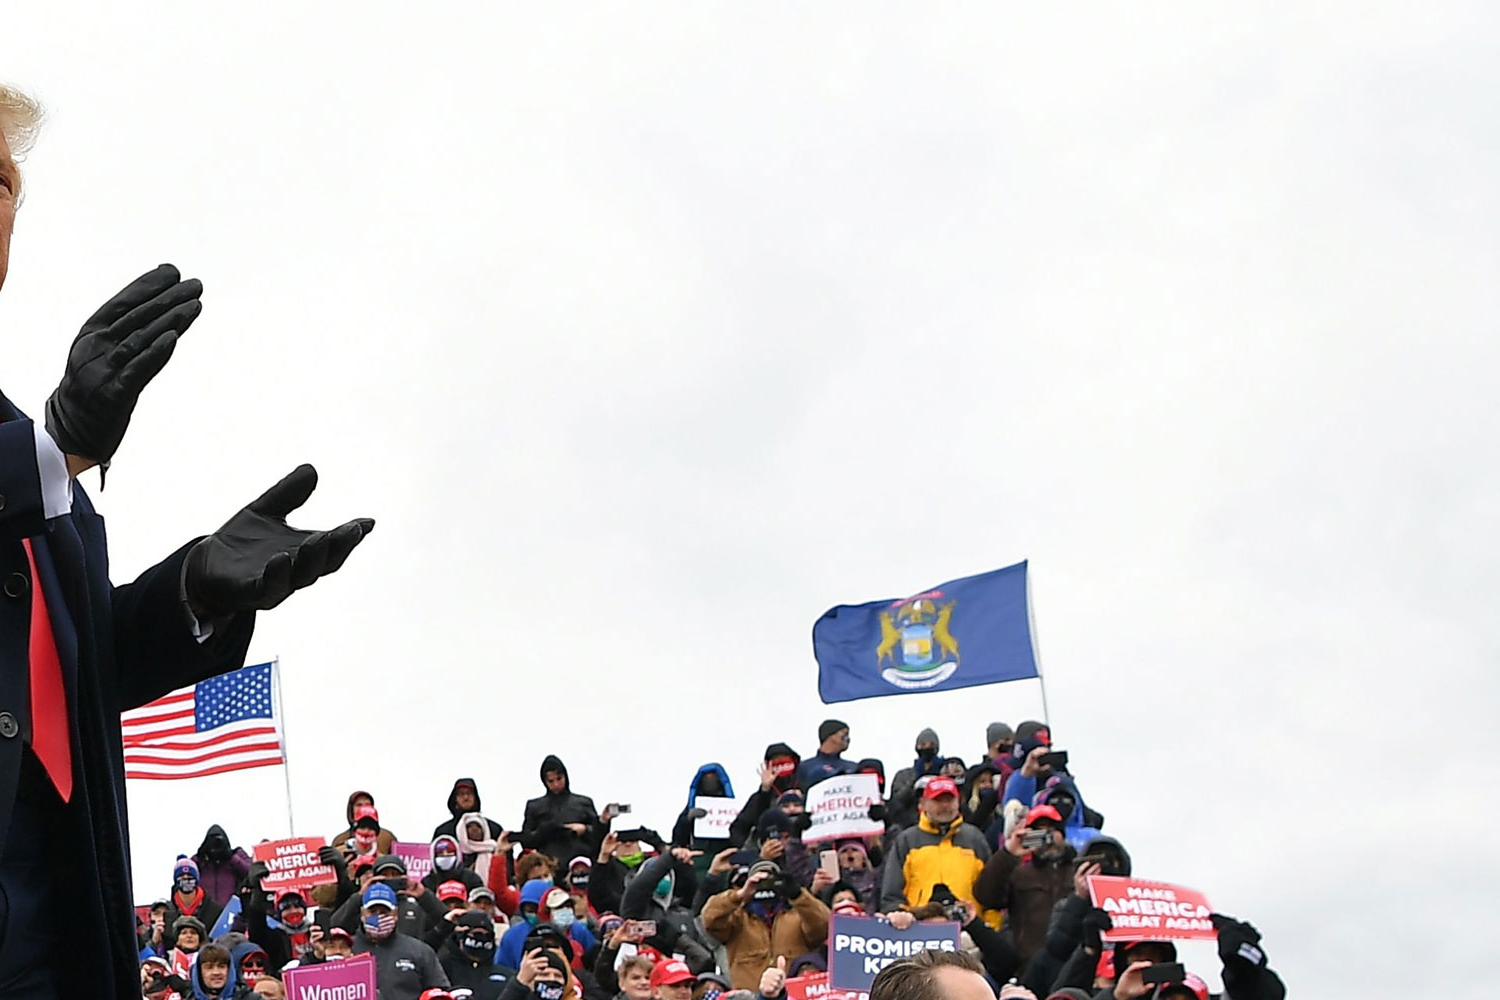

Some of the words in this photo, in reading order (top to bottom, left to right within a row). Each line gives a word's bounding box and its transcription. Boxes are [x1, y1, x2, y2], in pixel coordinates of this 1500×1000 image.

[276, 843, 306, 856] MAKE
[265, 853, 321, 872] AMERIC
[298, 866, 332, 878] AGAIN
[1127, 887, 1176, 901] MAKE
[1103, 898, 1211, 918] AMERICA
[464, 937, 493, 950] MAG
